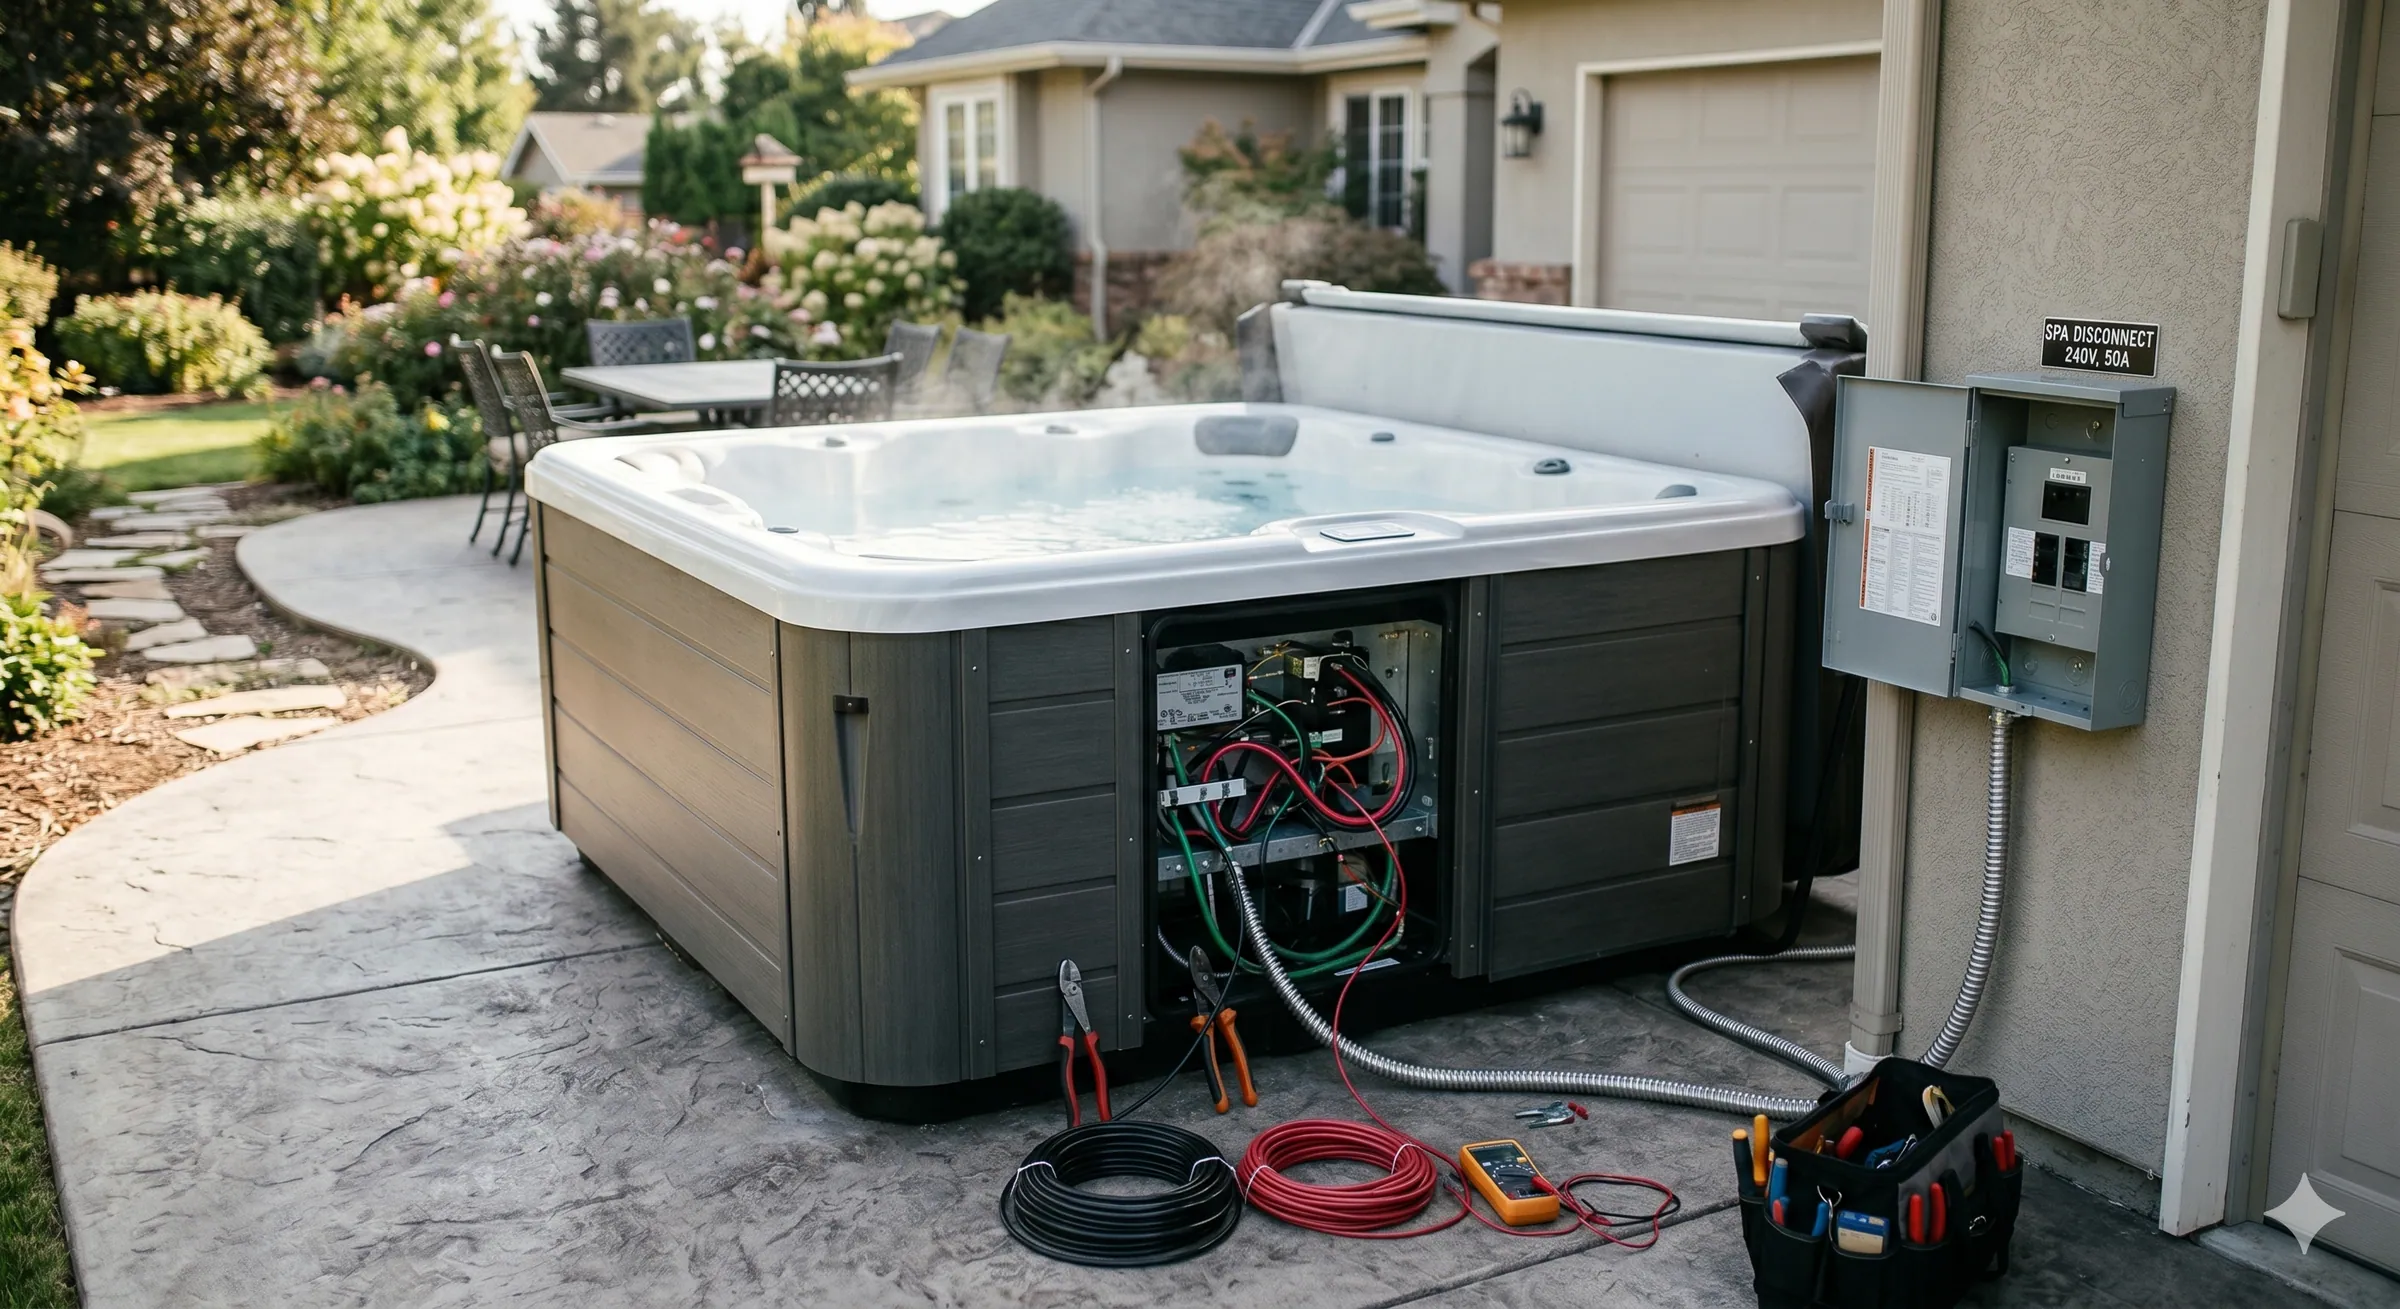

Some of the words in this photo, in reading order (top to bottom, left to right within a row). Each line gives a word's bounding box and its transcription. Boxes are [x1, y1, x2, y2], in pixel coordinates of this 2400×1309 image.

[2045, 324, 2069, 341] SPA
[2073, 326, 2154, 348] DISCONNECT
[2065, 347, 2099, 367] 240V,
[2104, 350, 2130, 367] 50A
